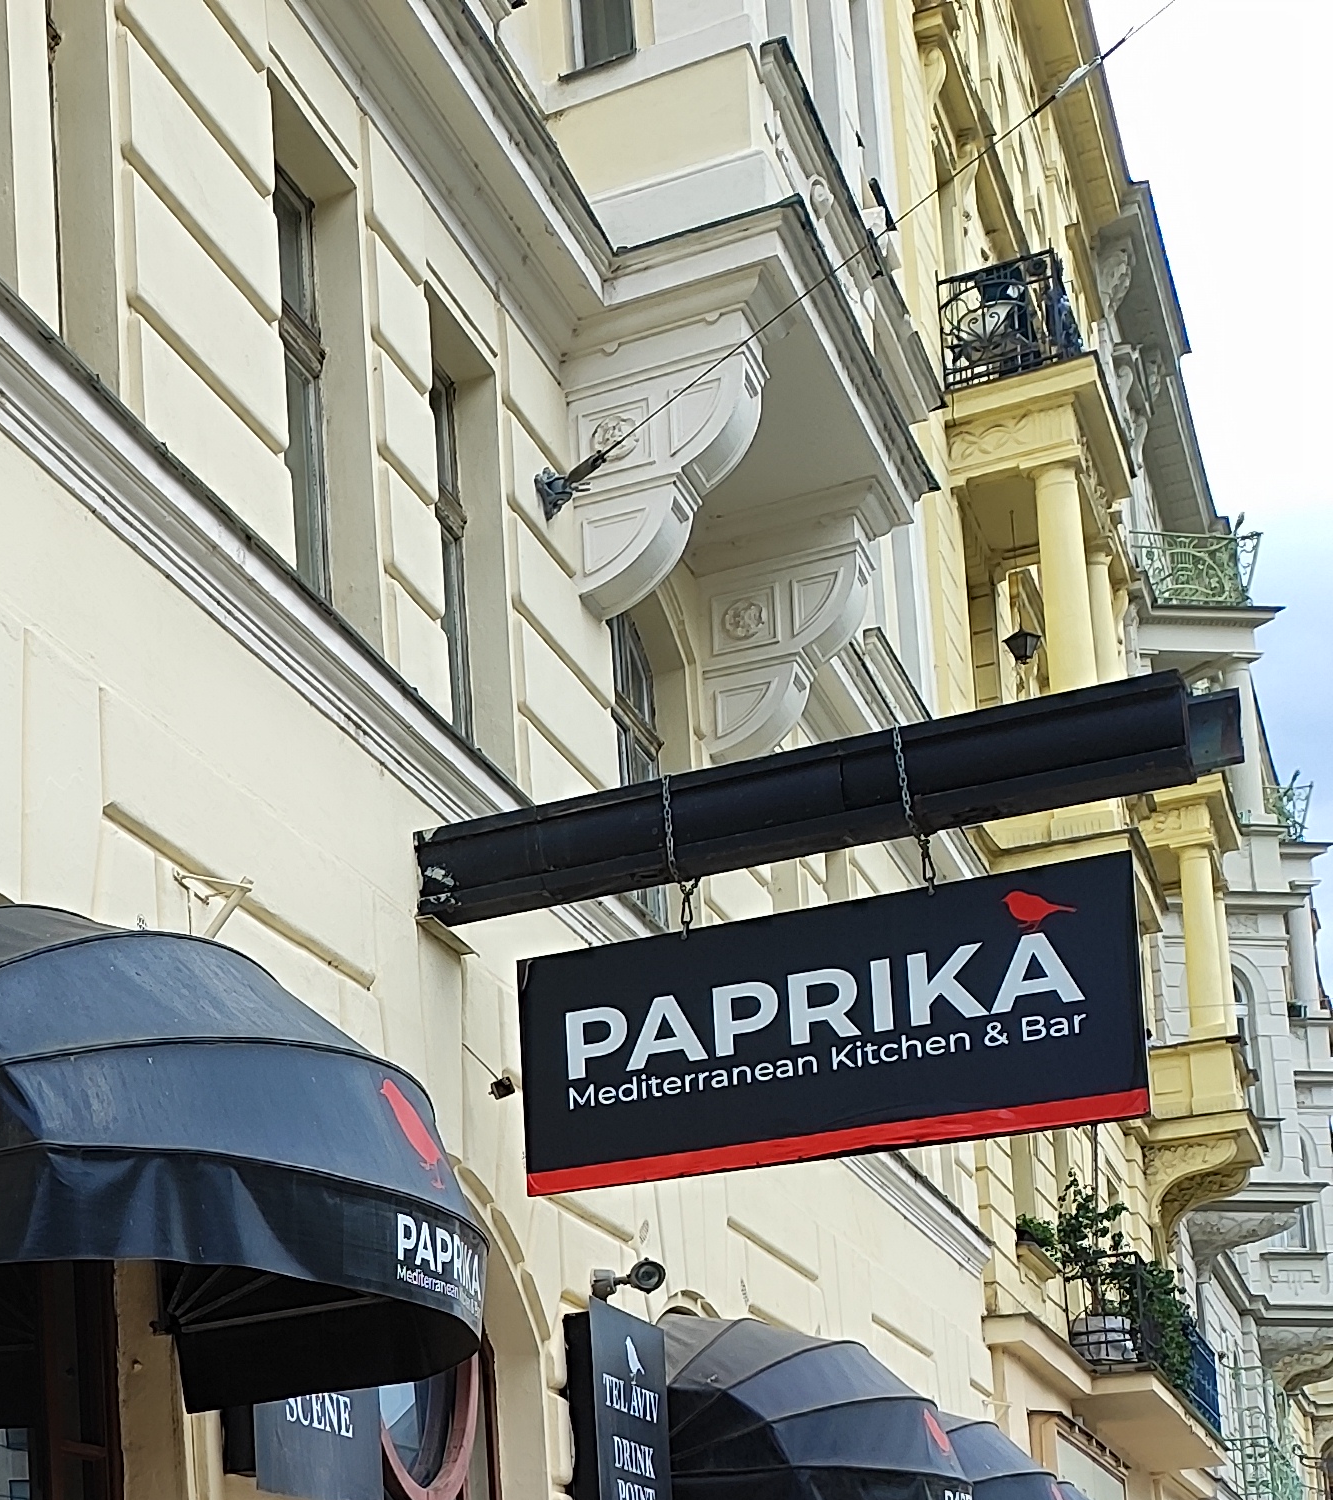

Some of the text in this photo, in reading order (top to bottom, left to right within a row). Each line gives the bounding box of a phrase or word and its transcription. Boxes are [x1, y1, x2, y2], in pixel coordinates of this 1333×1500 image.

[564, 932, 1086, 1081] PAPRIKA
[568, 1010, 1087, 1111] Mediterranean Kitchen & Bar
[396, 1212, 482, 1301] PAPRIKA
[396, 1263, 459, 1300] Mediterranean
[285, 1392, 353, 1439] SCENE
[602, 1372, 660, 1424] TEL AVIV
[613, 1435, 656, 1480] DRINK
